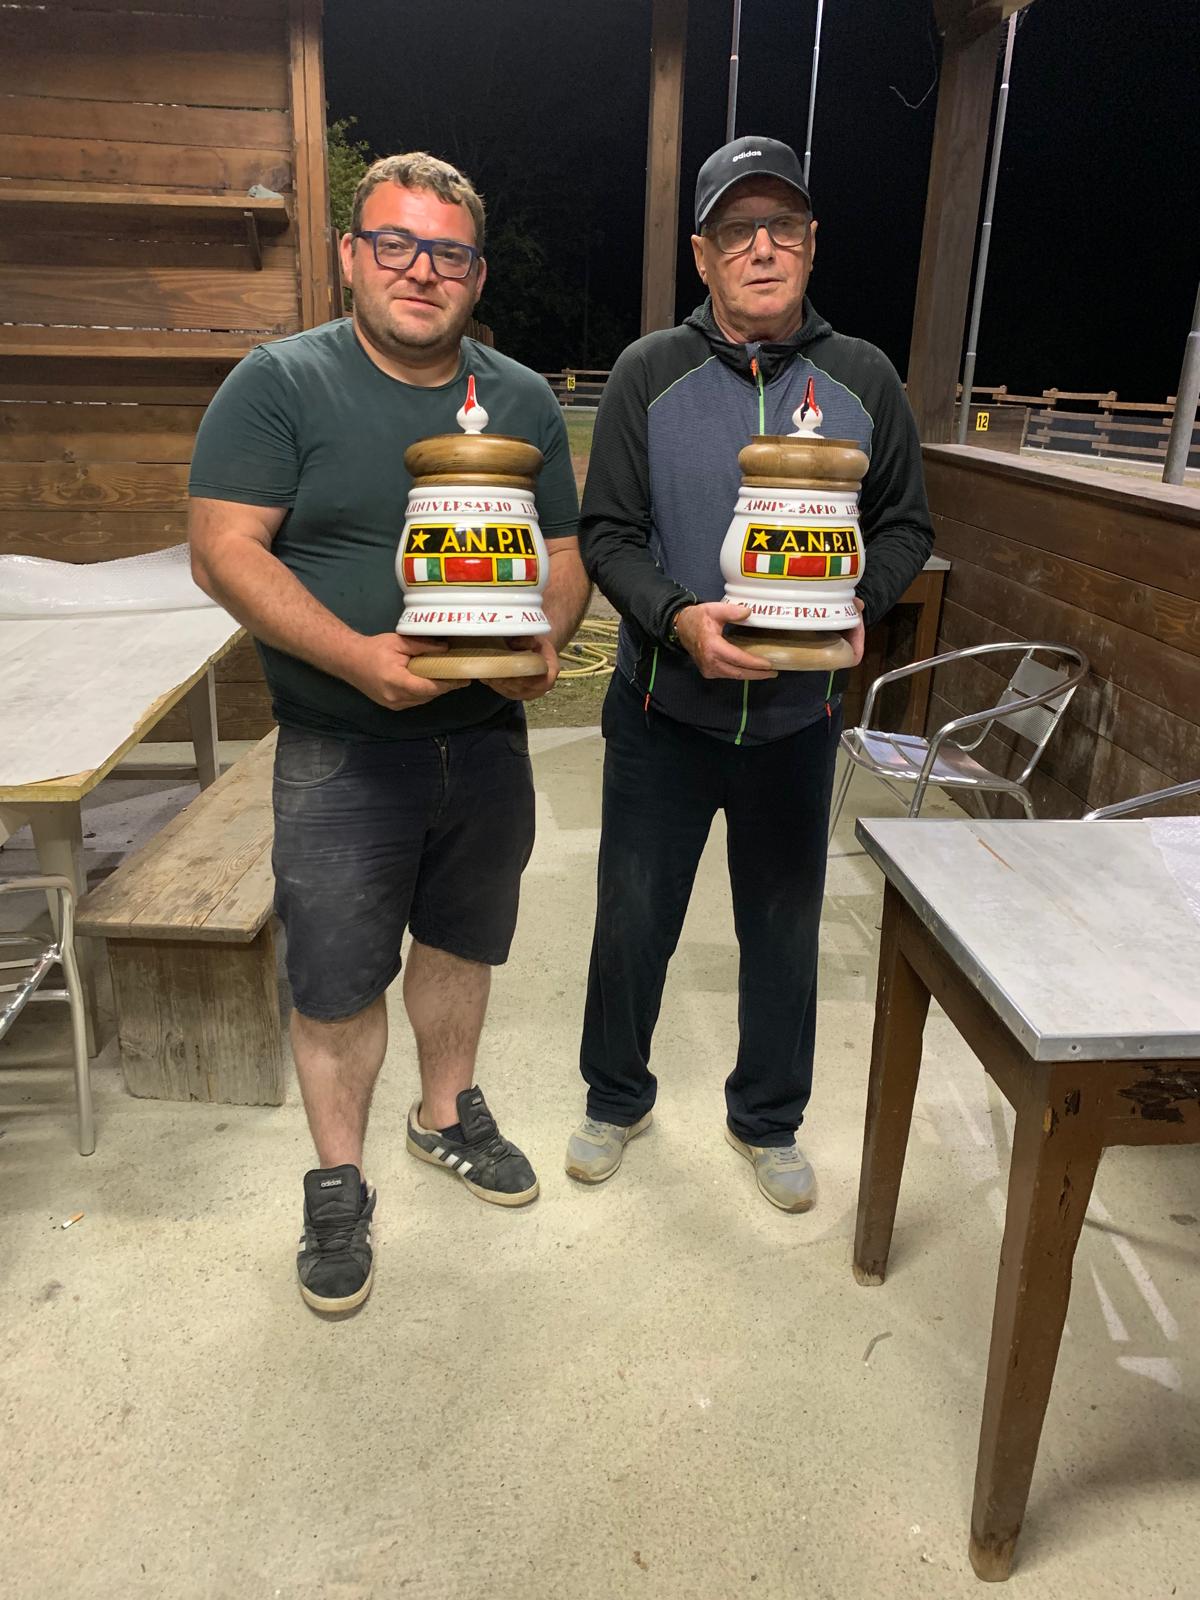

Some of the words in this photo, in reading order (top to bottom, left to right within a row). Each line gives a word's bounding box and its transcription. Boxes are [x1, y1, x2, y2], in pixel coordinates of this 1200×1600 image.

[732, 150, 762, 162] adidas
[978, 415, 988, 428] 12
[744, 499, 837, 515] ANNIVSARIO
[439, 527, 533, 554] A.N.P.I.
[780, 530, 856, 553] A.N.P.I.
[320, 1179, 342, 1188] adidas
